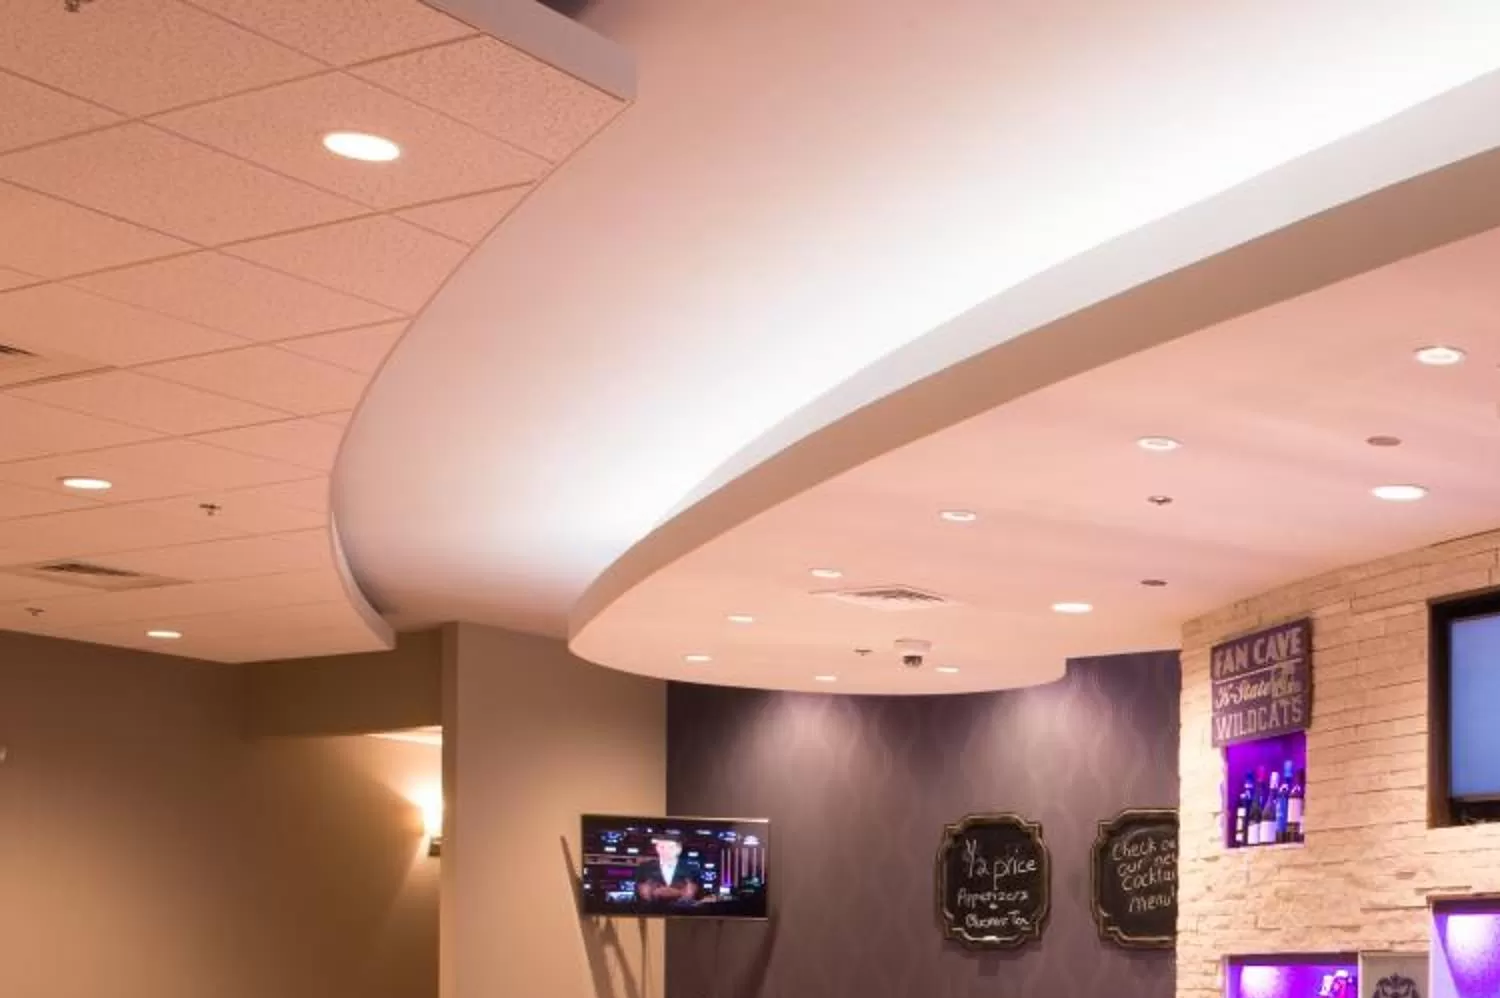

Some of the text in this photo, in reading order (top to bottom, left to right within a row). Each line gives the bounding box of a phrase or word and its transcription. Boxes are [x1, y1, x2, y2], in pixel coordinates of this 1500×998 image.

[1213, 627, 1302, 679] FAN CAVE
[1213, 697, 1302, 741] WILDCATS
[992, 848, 1037, 891] price
[1111, 836, 1157, 861] Check
[1117, 858, 1144, 877] our
